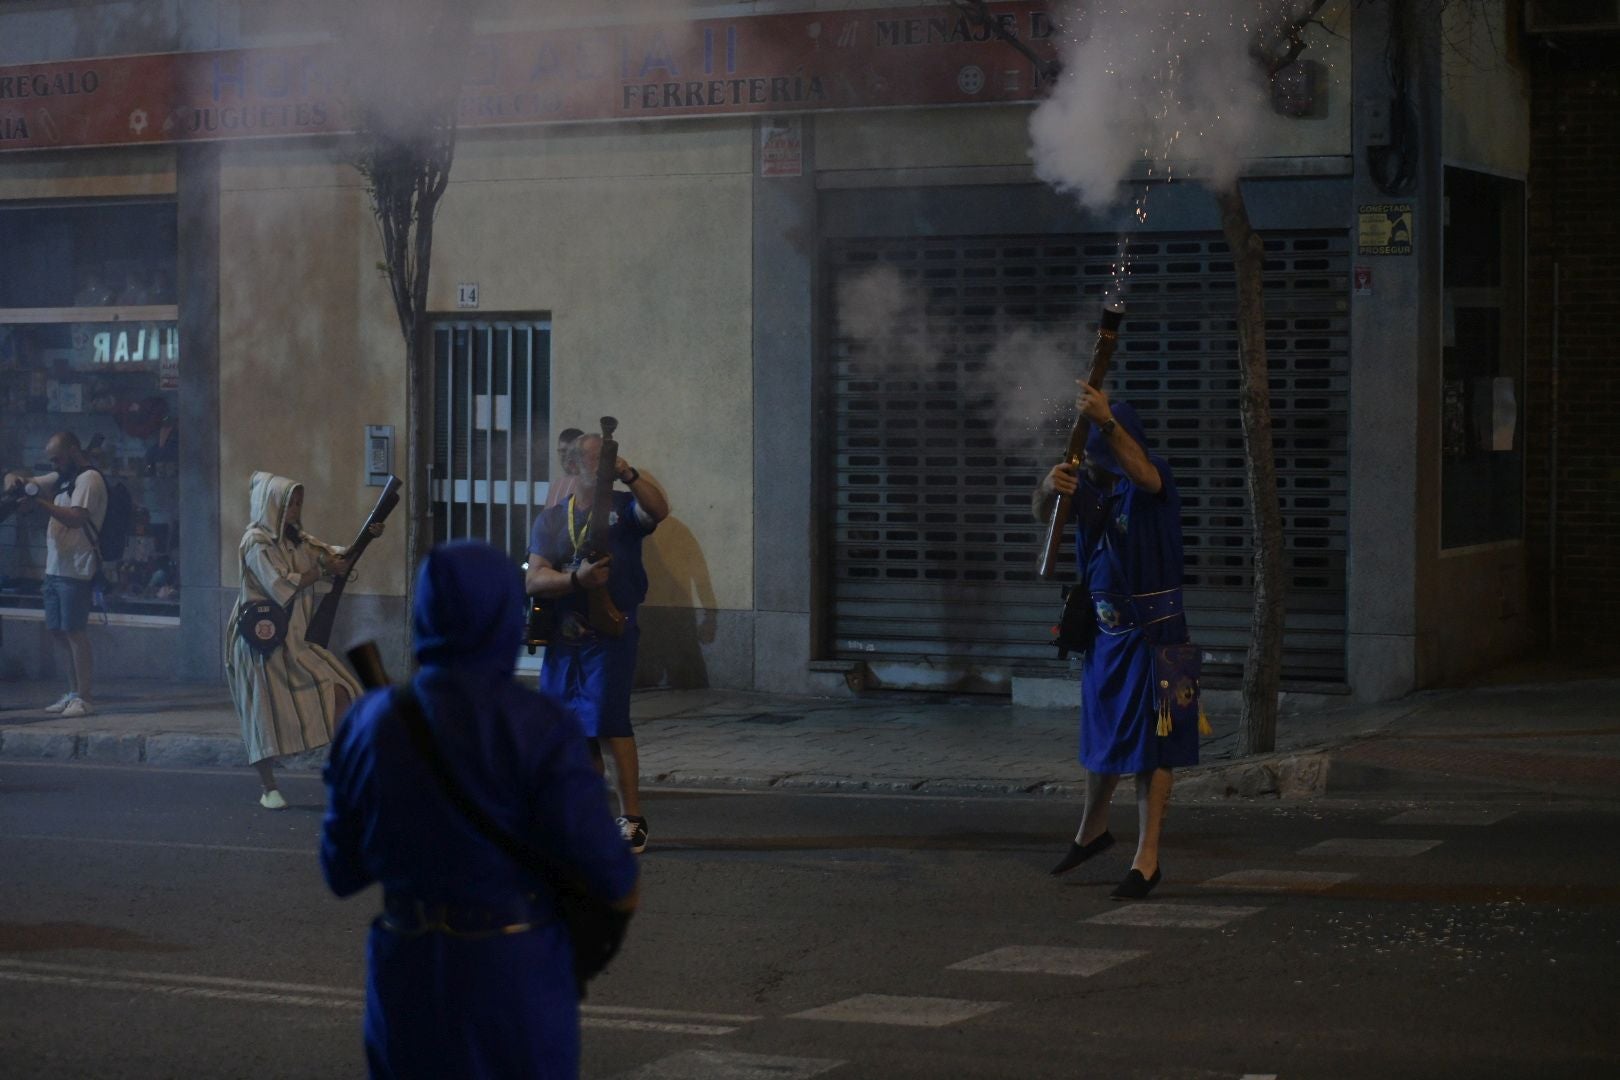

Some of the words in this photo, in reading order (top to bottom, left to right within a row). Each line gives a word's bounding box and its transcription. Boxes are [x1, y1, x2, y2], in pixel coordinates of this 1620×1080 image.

[874, 11, 1018, 47] MENAJE
[0, 70, 99, 99] REGALO
[622, 66, 826, 109] FERRETERÍA
[190, 101, 328, 133] JUGUETES
[1359, 204, 1412, 213] CONECTADA
[1360, 246, 1411, 255] PROSEGUR
[460, 287, 476, 302] 14
